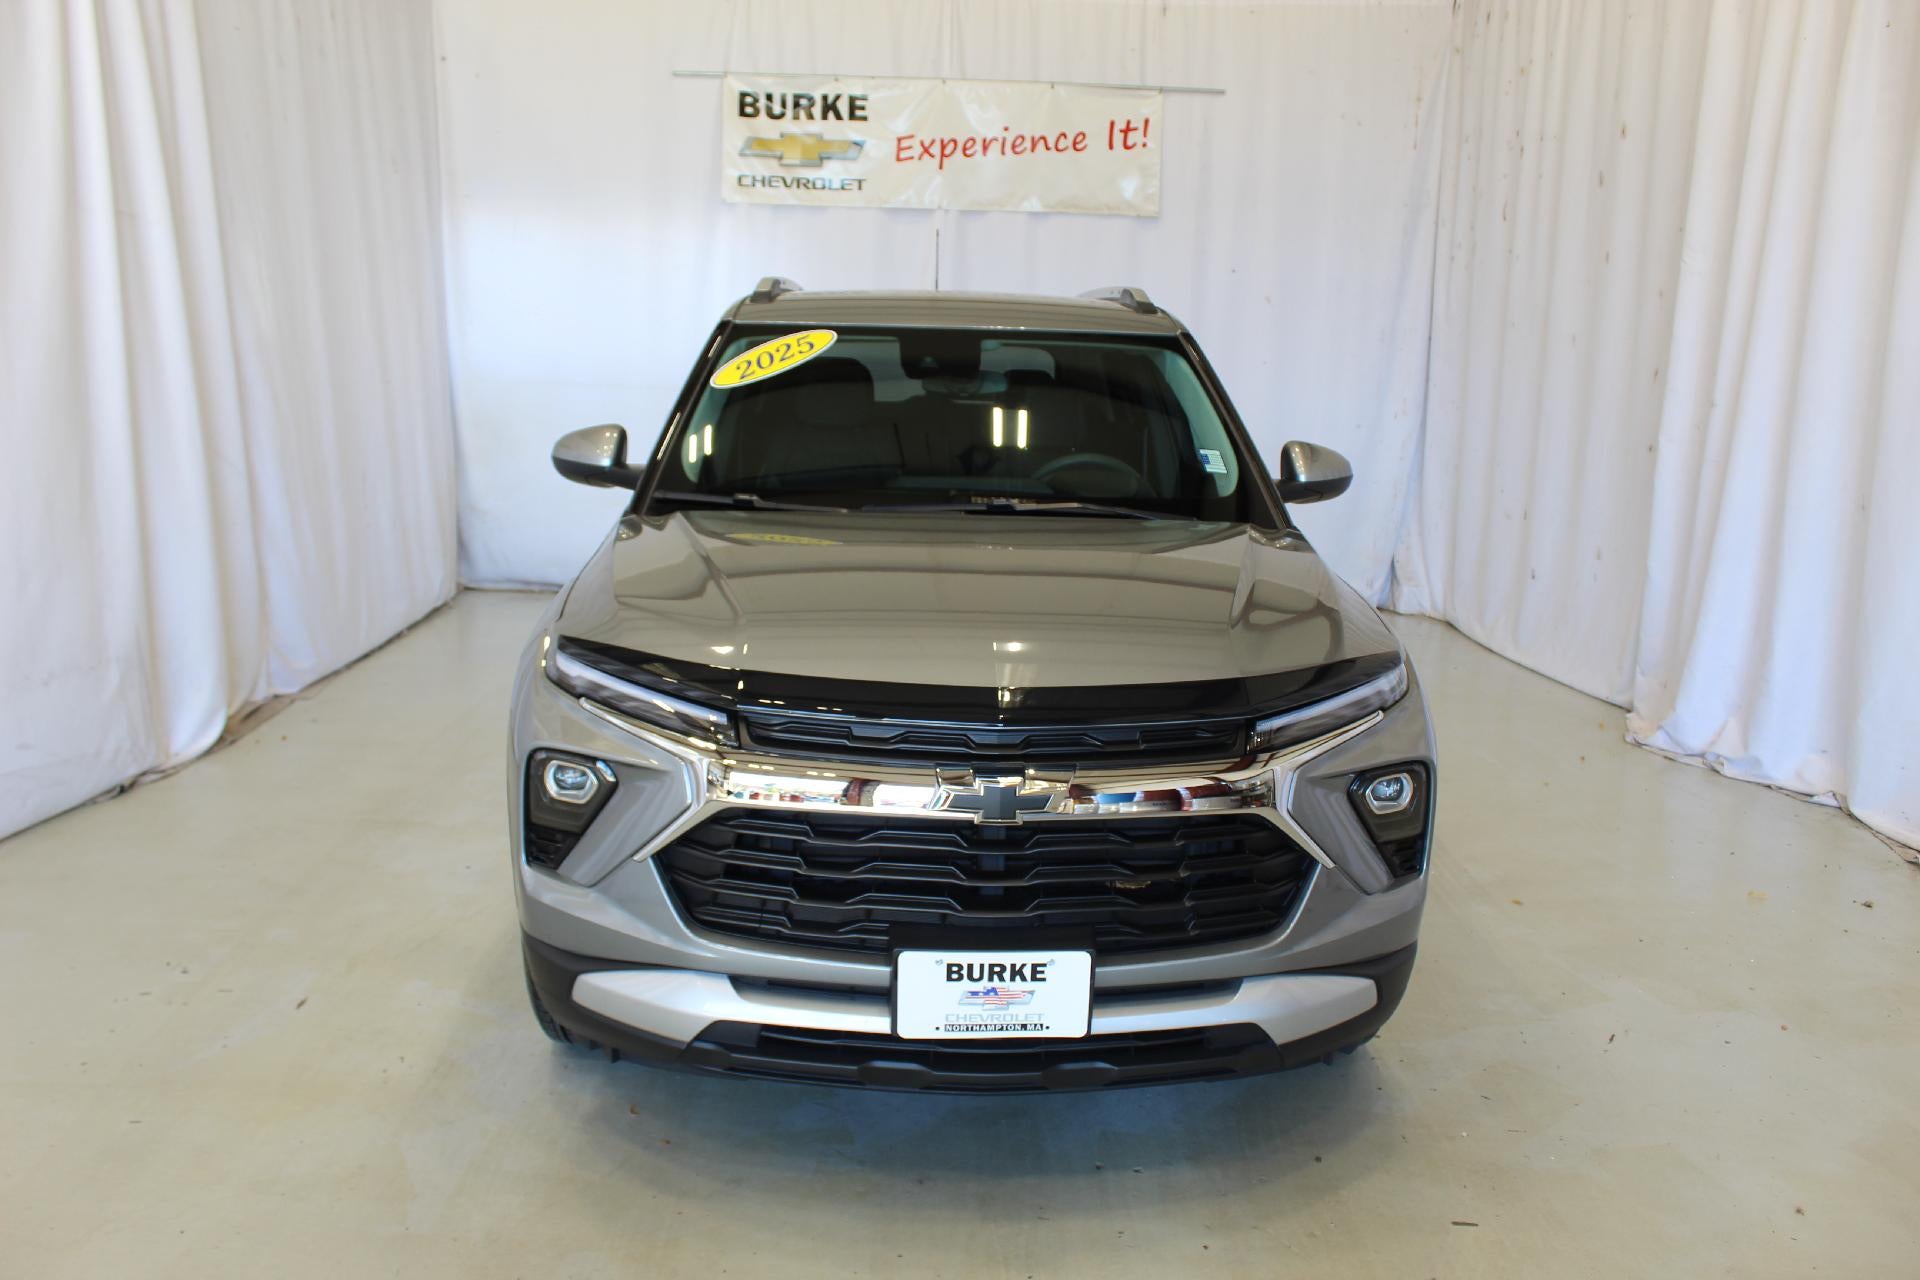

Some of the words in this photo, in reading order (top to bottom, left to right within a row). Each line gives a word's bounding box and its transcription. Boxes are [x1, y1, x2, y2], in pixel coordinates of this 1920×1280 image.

[738, 91, 868, 121] BURKE
[896, 127, 1087, 169] Experience
[1107, 118, 1150, 150] It!
[737, 174, 867, 191] CHEVROLET
[736, 335, 814, 380] 2025
[946, 963, 1046, 982] BURKE
[945, 1013, 1044, 1022] CHEVROLET
[1026, 1023, 1042, 1031] MA
